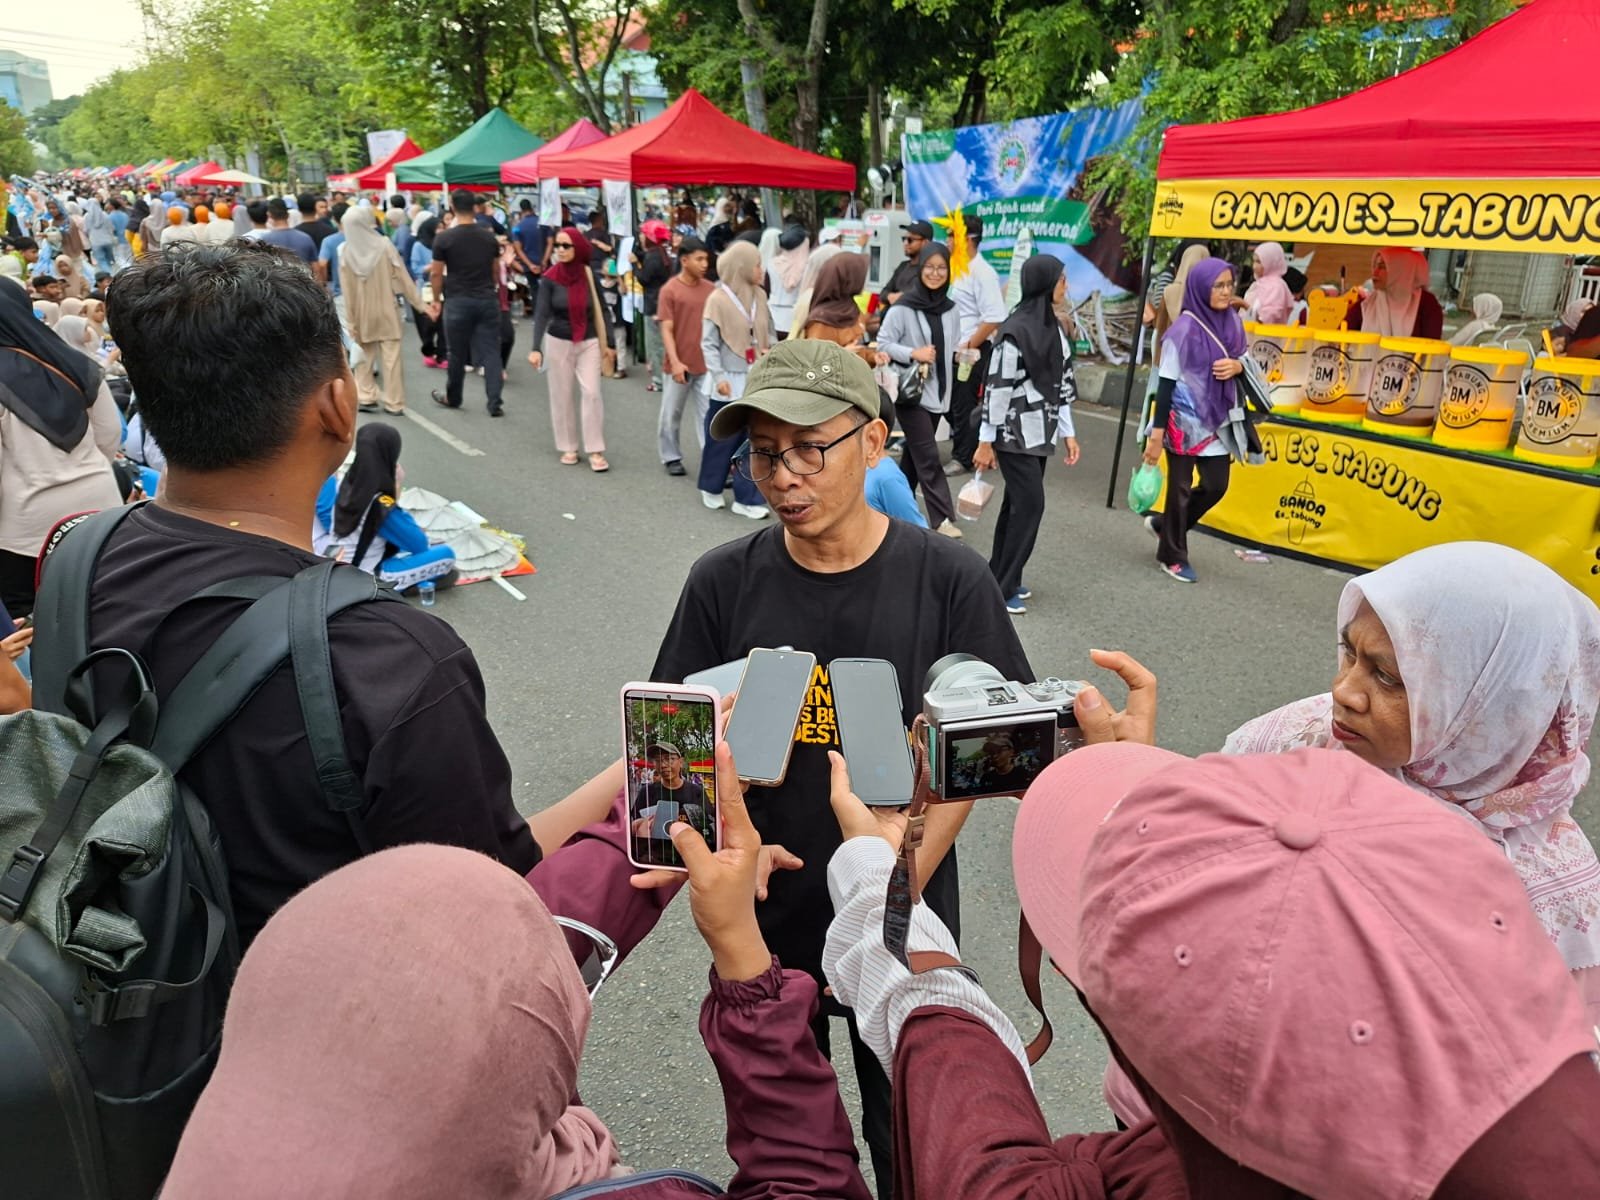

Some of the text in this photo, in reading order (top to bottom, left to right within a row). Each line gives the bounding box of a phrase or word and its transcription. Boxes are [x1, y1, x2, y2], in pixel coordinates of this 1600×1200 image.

[1211, 191, 1339, 232] BANDA
[1315, 366, 1334, 382] BM
[1382, 375, 1403, 393] BM
[1450, 386, 1471, 405] BM
[1536, 399, 1561, 419] BM
[1279, 495, 1326, 517] BANDA
